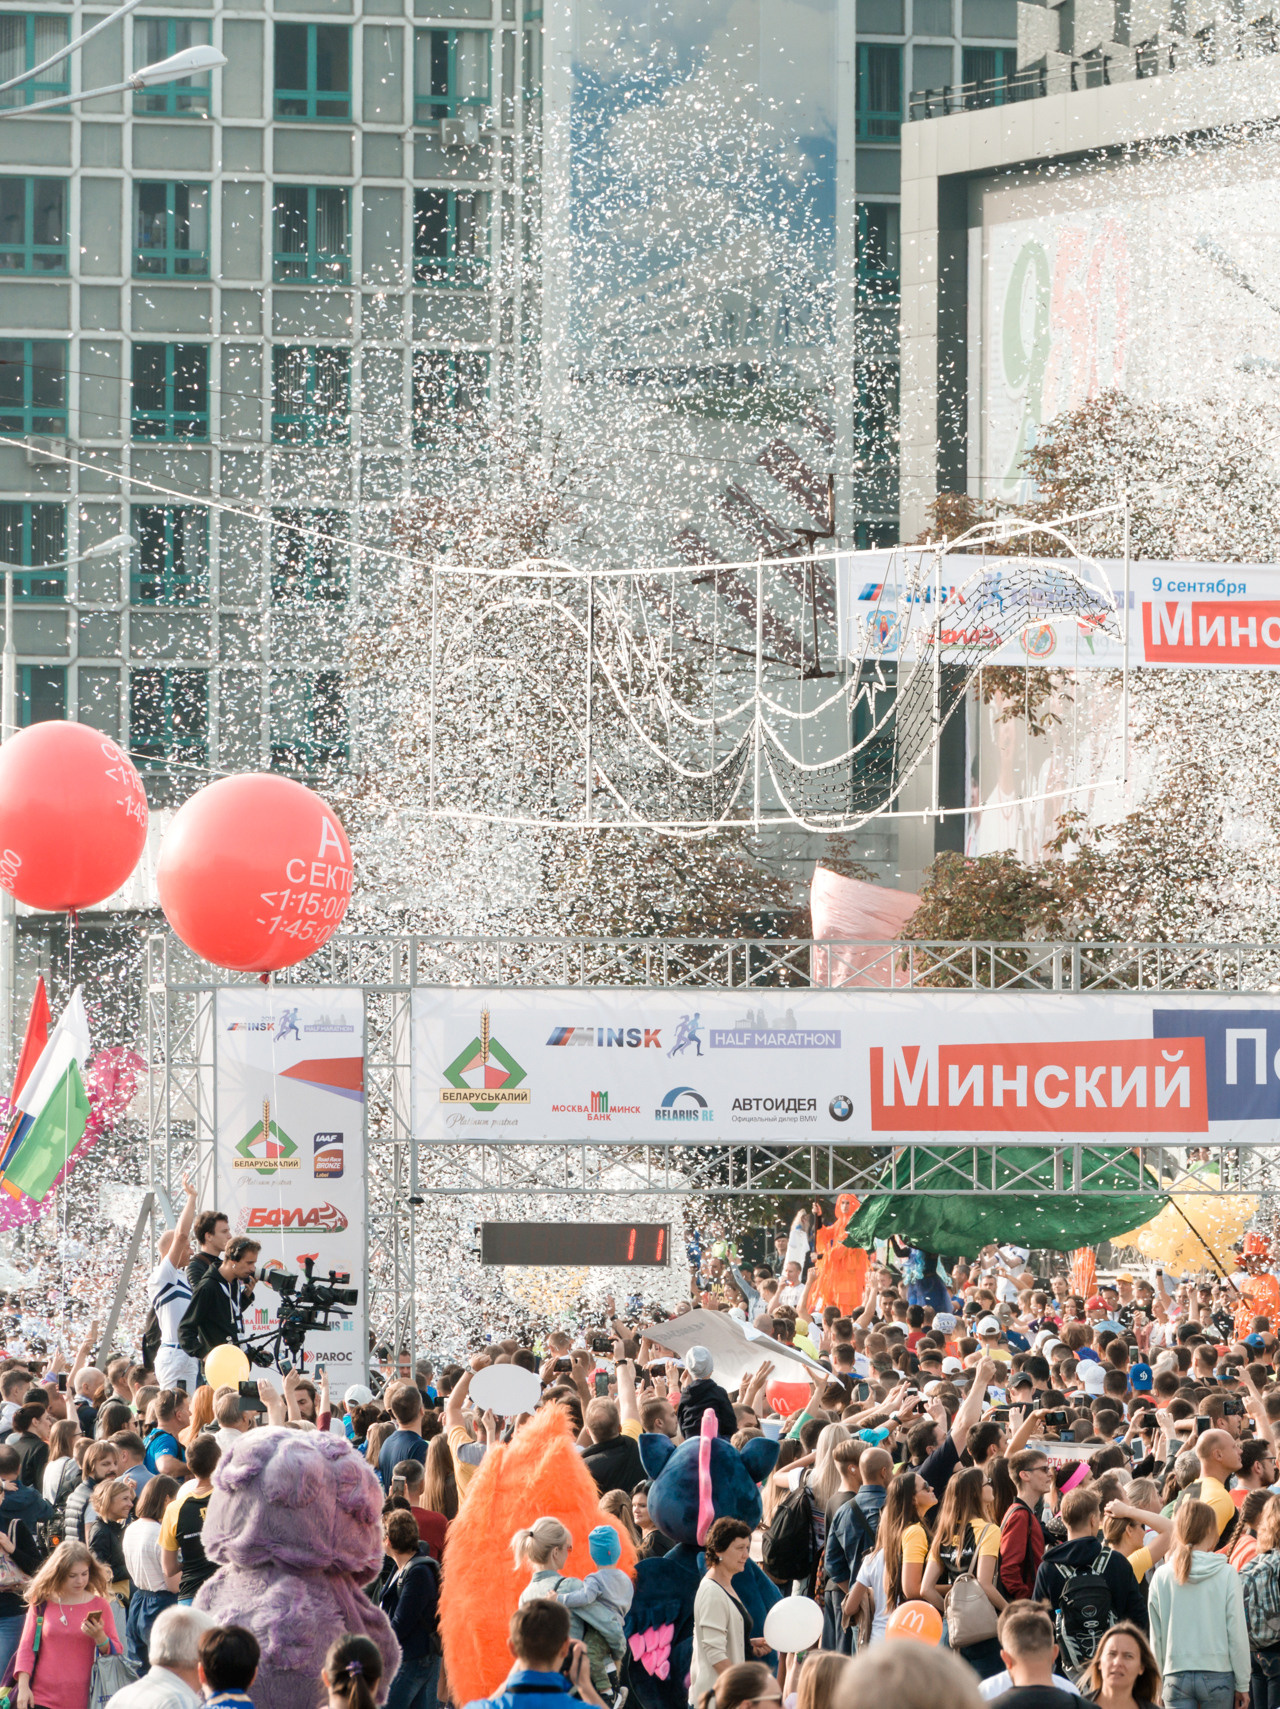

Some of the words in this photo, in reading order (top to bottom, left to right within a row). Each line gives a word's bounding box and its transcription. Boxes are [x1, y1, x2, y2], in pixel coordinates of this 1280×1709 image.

[1152, 577, 1163, 592] 9
[1167, 578, 1247, 597] сентября
[318, 815, 346, 863] А
[286, 858, 353, 894] СЕКТО
[546, 1026, 662, 1048] MINSK
[714, 1033, 751, 1046] HALF
[754, 1033, 836, 1046] MARATHON
[881, 1045, 1191, 1109] Минский
[442, 1091, 528, 1101] БЕЛАРУСЬКАЛИЙ
[552, 1105, 589, 1113] МОСКВА
[610, 1106, 641, 1114] МИНСК
[731, 1098, 817, 1113] АВТОИДЕЯ
[587, 1113, 611, 1121] БАНК
[655, 1109, 699, 1122] BELARUS
[702, 1109, 714, 1122] RE
[731, 1115, 777, 1123] Официальный
[234, 1160, 299, 1168] БЕЛАРУСЬКАЛИЙ
[247, 1207, 320, 1227] БФЛА
[316, 1352, 352, 1361] PAROC
